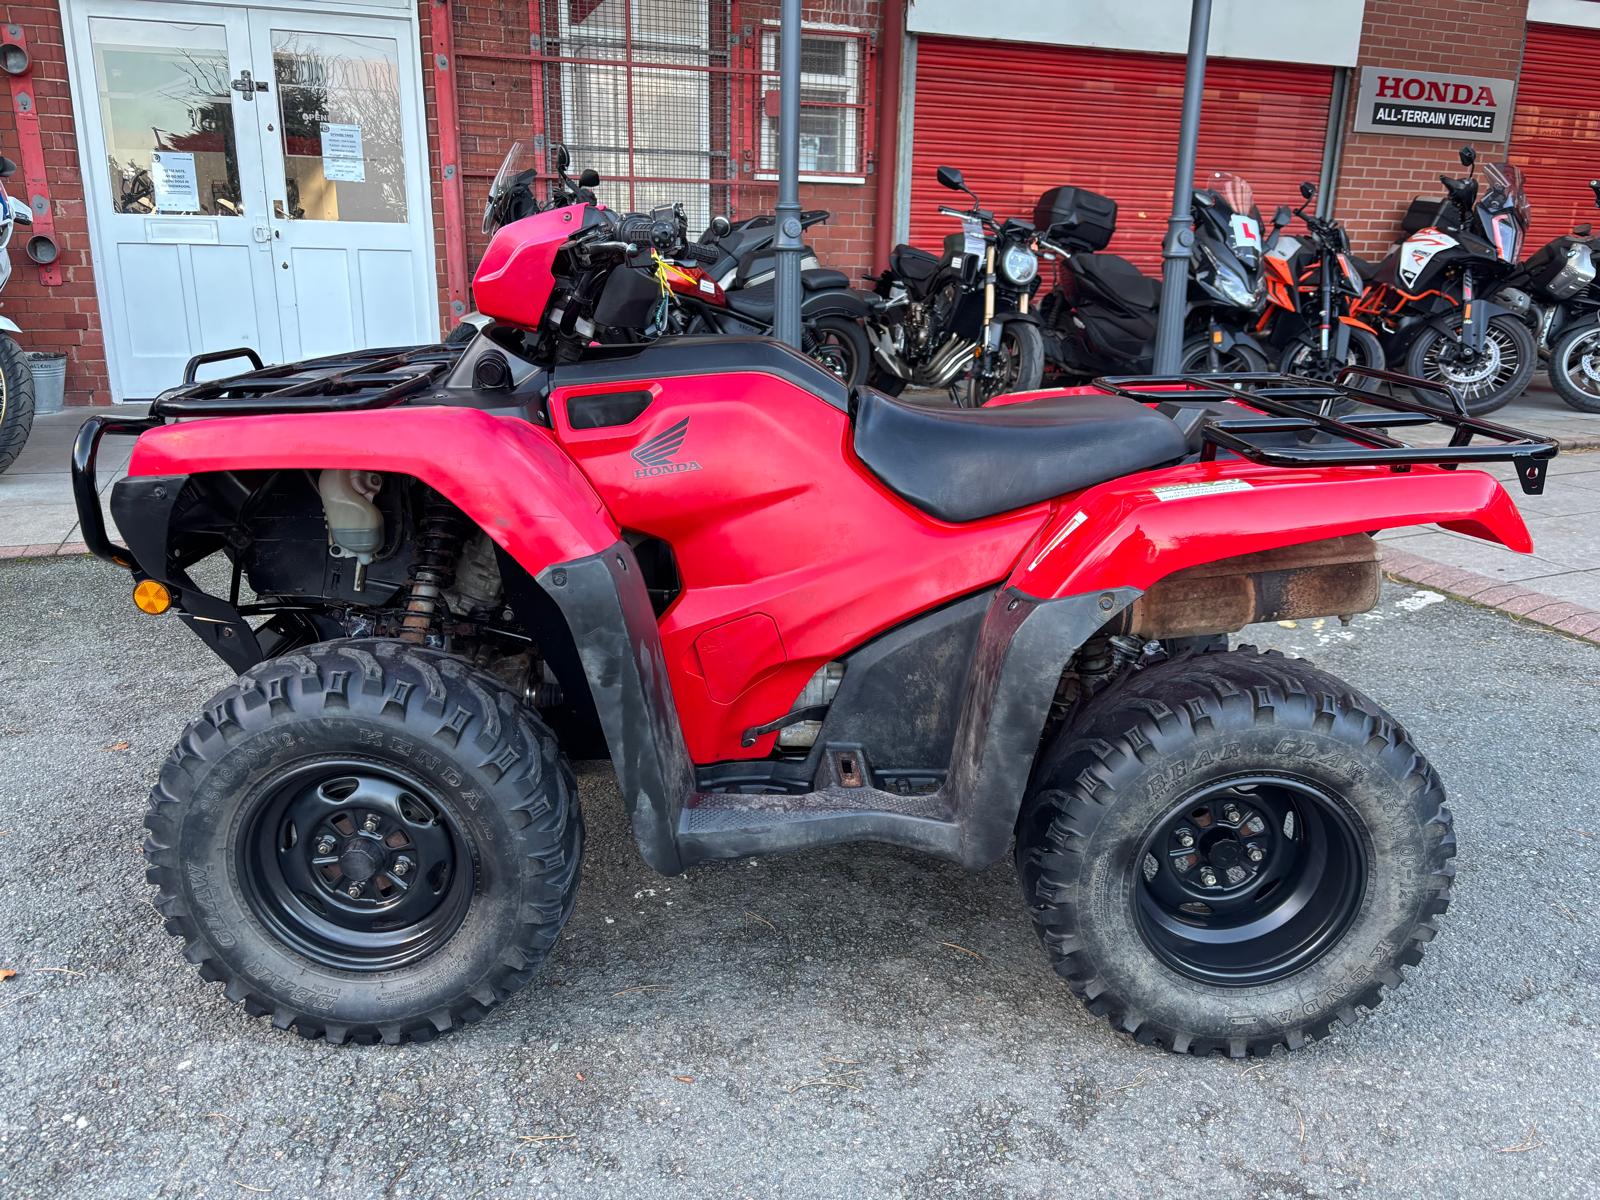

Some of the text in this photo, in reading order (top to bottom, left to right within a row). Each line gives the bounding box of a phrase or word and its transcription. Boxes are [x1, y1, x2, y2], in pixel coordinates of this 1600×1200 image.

[1375, 75, 1497, 107] HONDA
[302, 112, 327, 121] OPEN
[1376, 107, 1492, 128] ALL-TERRAIN VEHICLE
[1242, 222, 1257, 241] L
[634, 461, 703, 479] HONDA
[358, 728, 482, 811] KENDA
[1147, 741, 1241, 796] BEAR
[245, 960, 338, 1011] BEAR
[1271, 940, 1393, 1026] KENDA
